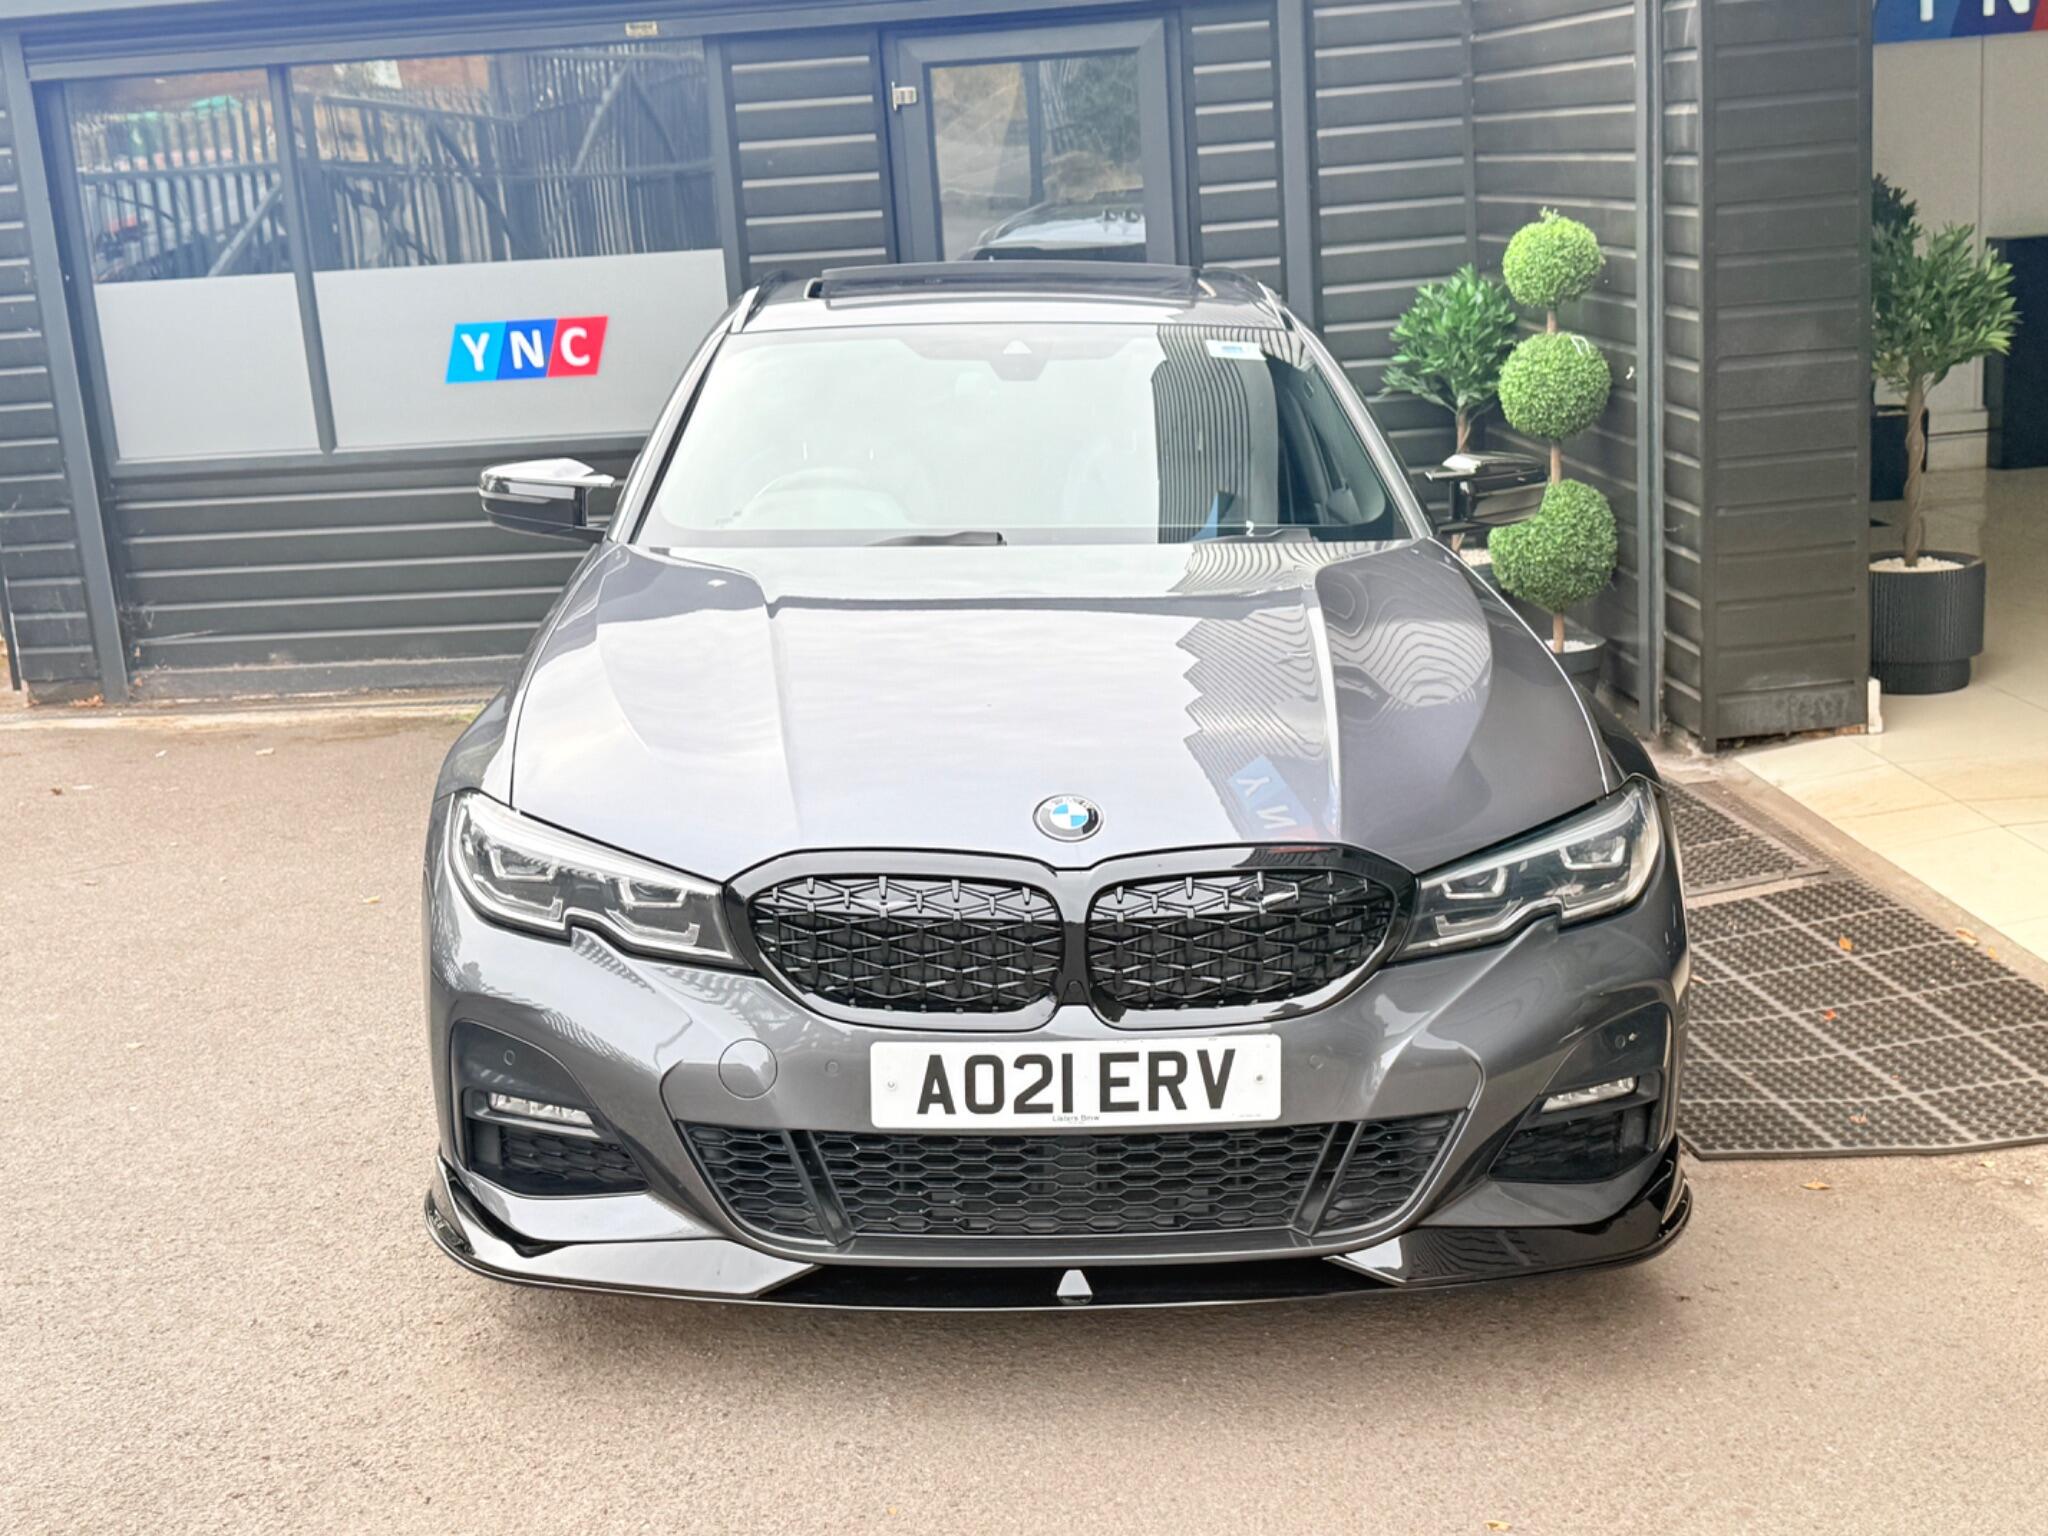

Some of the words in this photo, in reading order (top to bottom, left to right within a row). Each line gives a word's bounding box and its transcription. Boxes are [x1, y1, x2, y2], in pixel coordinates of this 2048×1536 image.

[460, 326, 591, 372] YNC
[916, 1053, 1074, 1115] AO21
[1099, 1048, 1236, 1112] ERV
